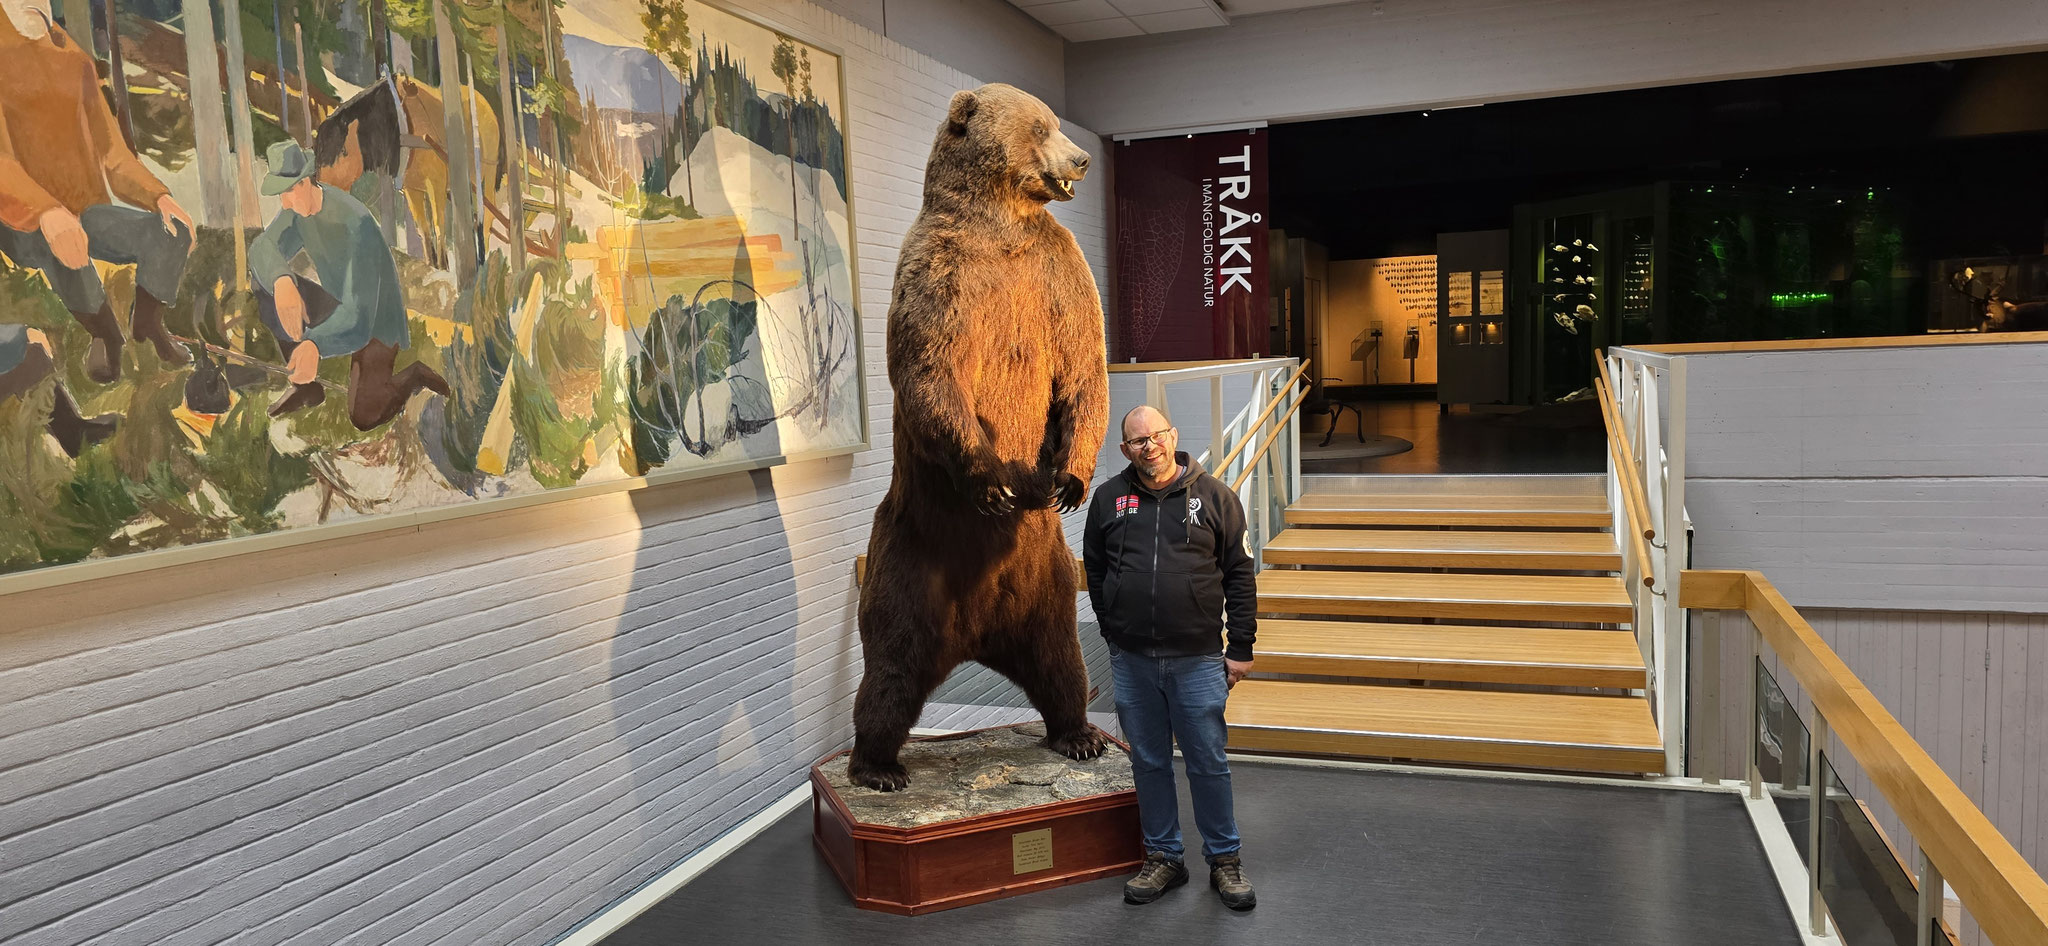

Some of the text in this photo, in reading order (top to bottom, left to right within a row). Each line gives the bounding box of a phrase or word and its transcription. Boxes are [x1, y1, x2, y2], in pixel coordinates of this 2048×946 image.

[1202, 184, 1214, 265] MANGFOLDIG
[1218, 145, 1262, 296] TRÅKK
[1203, 268, 1214, 307] NATUR
[1116, 507, 1138, 518] NOGE
